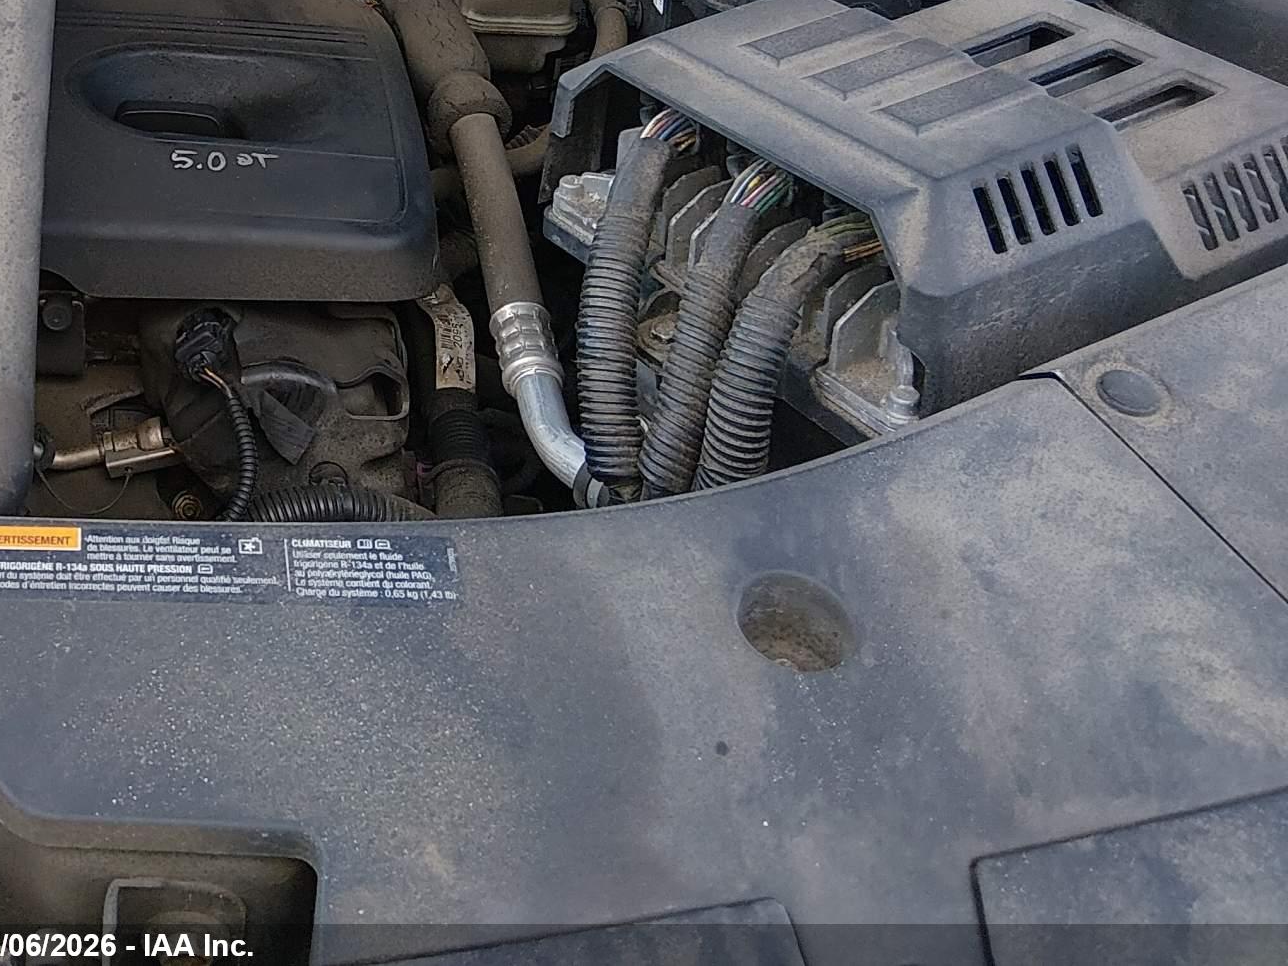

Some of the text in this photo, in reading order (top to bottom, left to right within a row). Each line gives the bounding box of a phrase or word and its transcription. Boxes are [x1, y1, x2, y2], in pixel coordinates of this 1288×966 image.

[170, 149, 227, 172] 5.0
[172, 536, 200, 546] Risque
[292, 538, 352, 548] CLIMATISEUR
[87, 544, 98, 552] de
[143, 545, 153, 553] Le
[155, 545, 198, 554] ventilateur
[200, 546, 219, 555] peut
[87, 553, 114, 561] mettre
[123, 553, 153, 561] tourner
[155, 554, 176, 562] sans
[323, 551, 368, 560] seulement
[379, 552, 403, 561] fluide
[55, 562, 88, 572] R-134a
[89, 563, 114, 573] SOUS
[116, 564, 145, 573] HAUTE
[147, 564, 192, 574] PRESSION
[384, 562, 396, 570] de
[6, 570, 17, 580] du
[56, 571, 72, 581] doit
[128, 574, 142, 583] par
[143, 575, 155, 583] un
[157, 575, 199, 584] personnel
[116, 583, 151, 592] peuvent
[152, 584, 181, 592] causer
[182, 584, 199, 593] des
[345, 580, 380, 588] contient
[382, 580, 394, 589] du
[296, 587, 327, 598] Charge
[328, 588, 340, 596] du
[406, 590, 419, 600] kg
